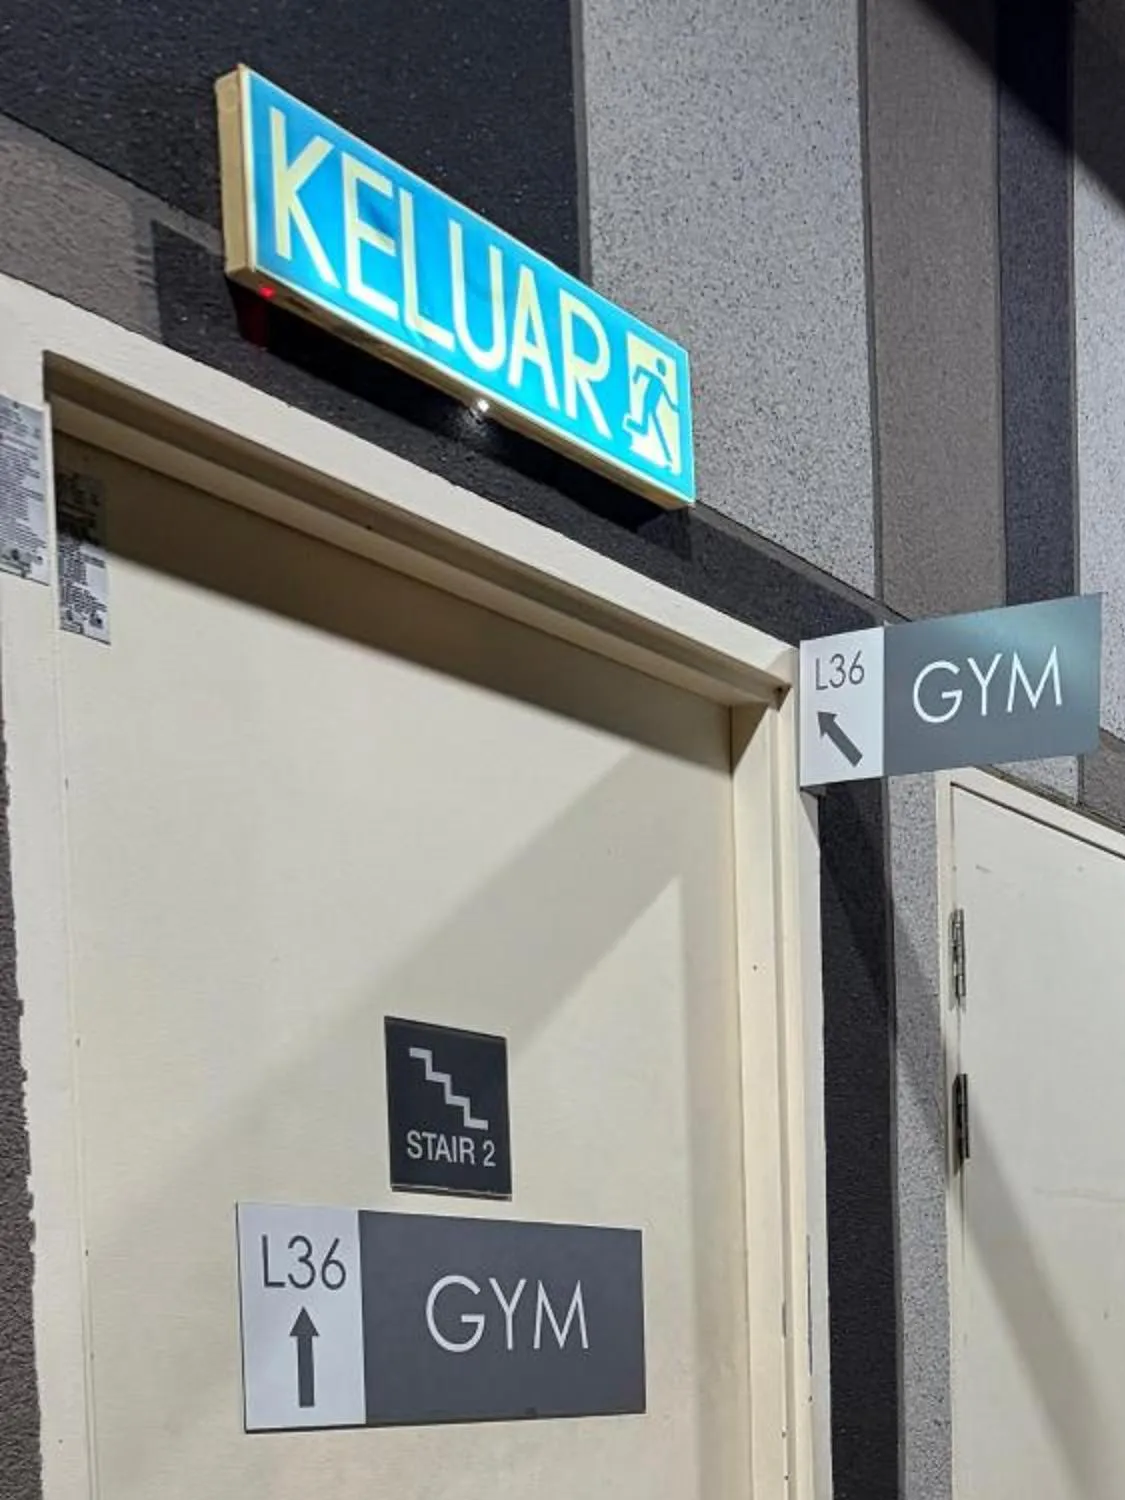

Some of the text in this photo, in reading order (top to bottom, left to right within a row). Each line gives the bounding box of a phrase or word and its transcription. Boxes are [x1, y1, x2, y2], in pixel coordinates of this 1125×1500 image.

[268, 105, 614, 442] KELUAR
[814, 650, 866, 691] L36
[913, 645, 1064, 723] GYM
[406, 1129, 497, 1168] STAIR 2
[260, 1234, 347, 1291] L36
[425, 1274, 590, 1353] GYM
